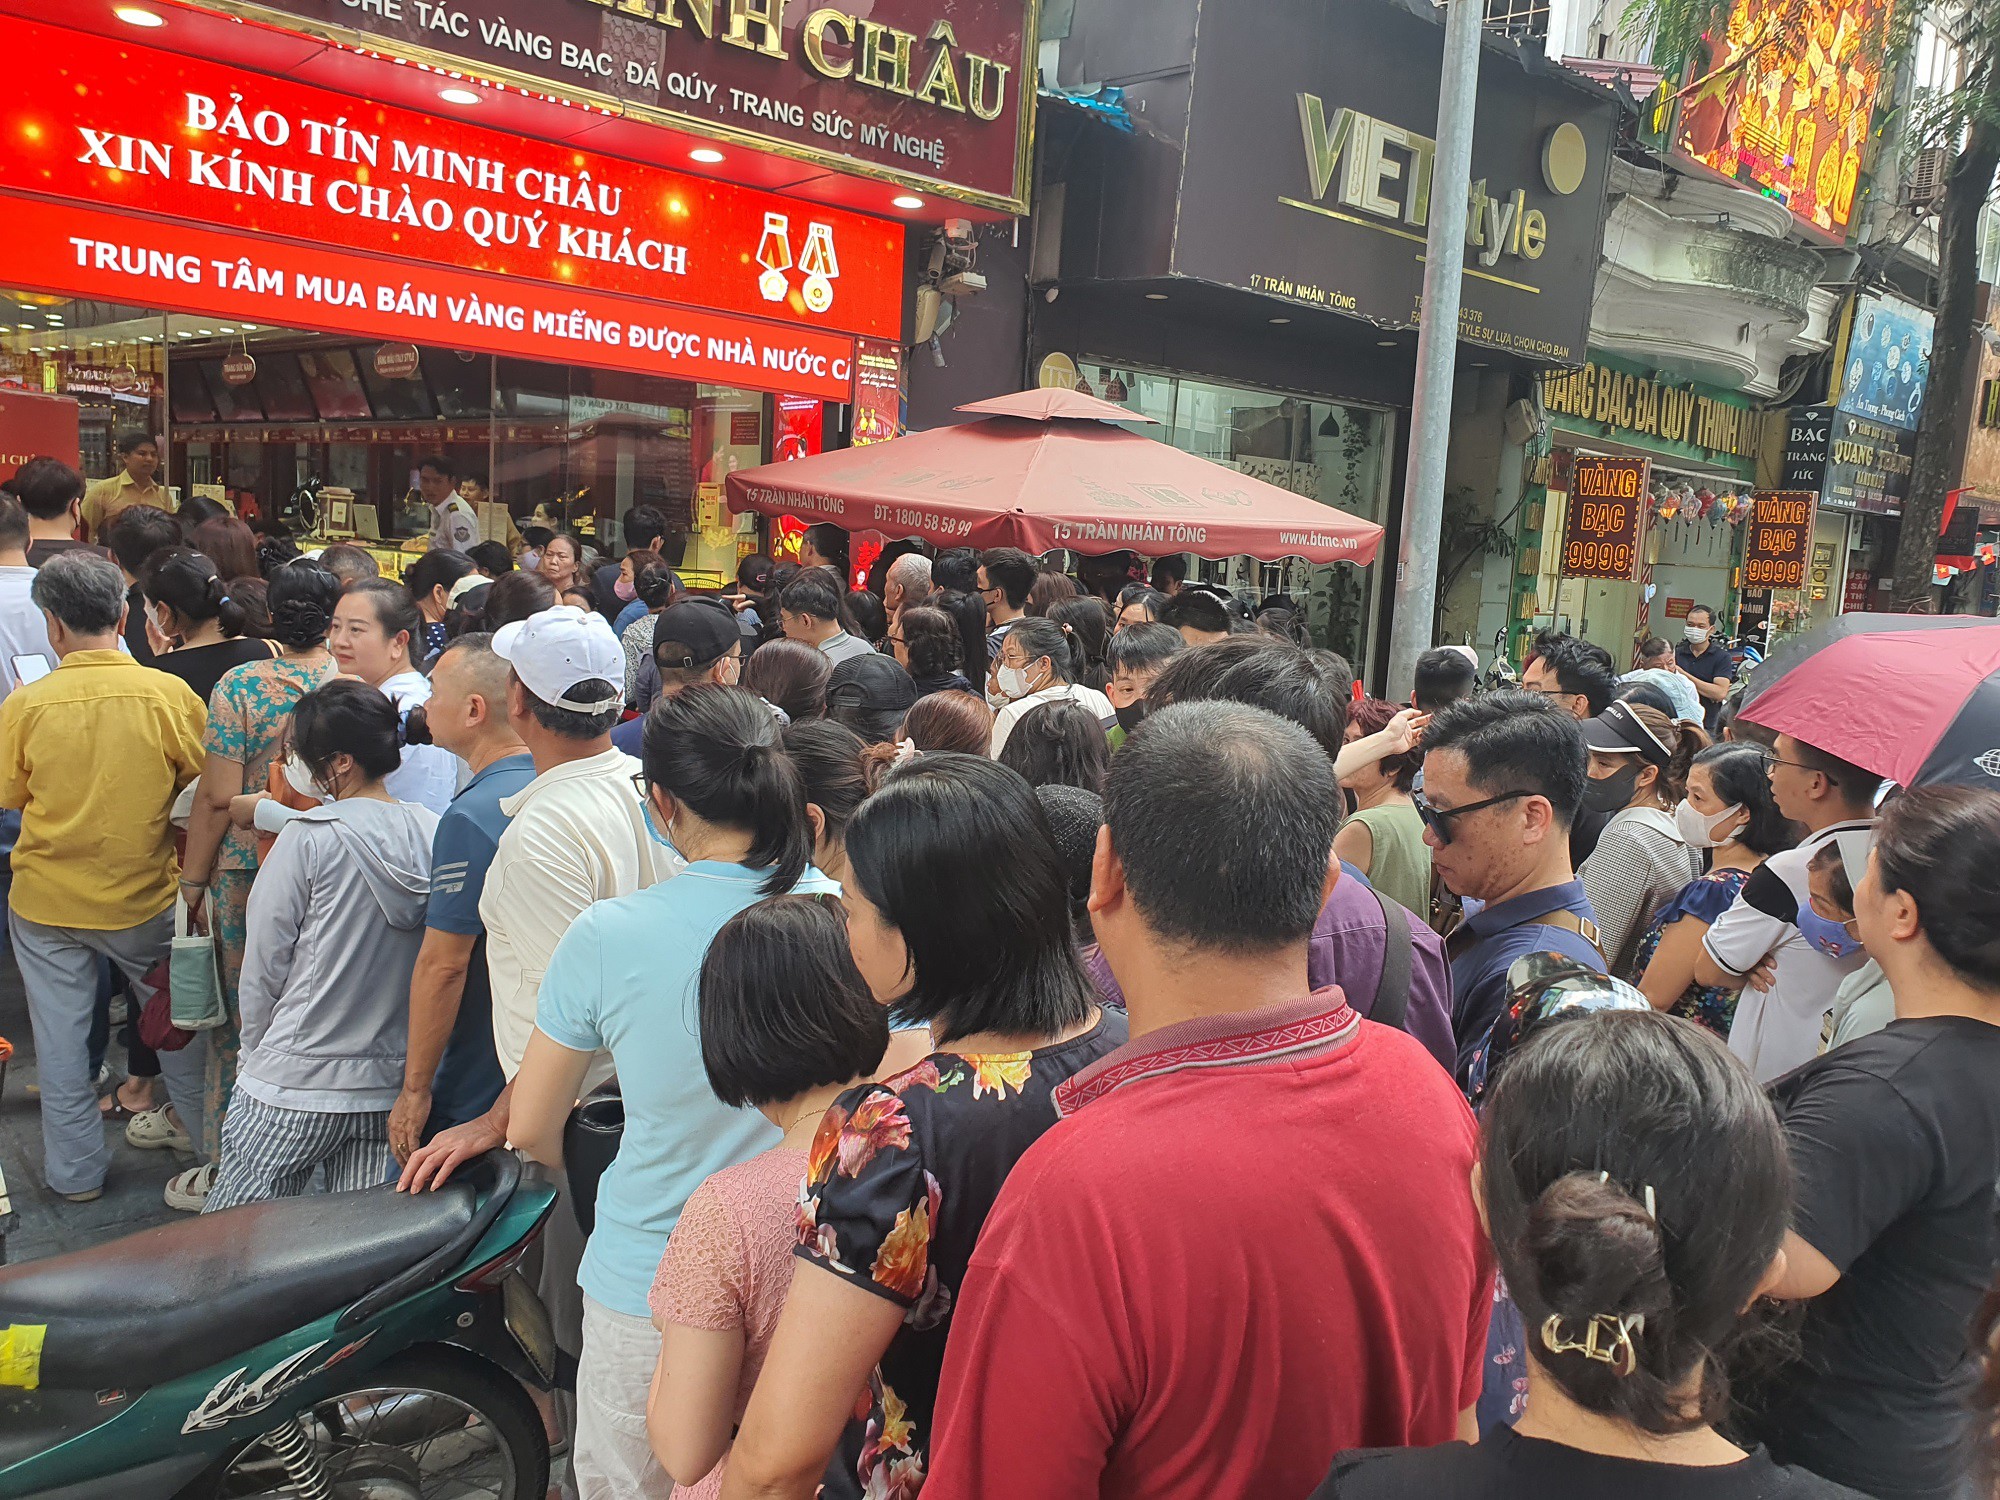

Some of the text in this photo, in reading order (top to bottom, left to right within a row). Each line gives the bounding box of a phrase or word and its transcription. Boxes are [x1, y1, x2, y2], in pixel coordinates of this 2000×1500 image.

[804, 8, 1011, 121] CHÂU
[413, 1, 470, 37] TÁC
[478, 16, 552, 60] VÀNG
[560, 42, 613, 78] BẠC
[625, 58, 660, 90] ĐÁ
[730, 88, 804, 127] TRANG
[812, 108, 853, 140] SỨC
[860, 122, 888, 149] MỸ
[893, 136, 945, 169] NGHỆ
[185, 92, 622, 217] BẢO TÍN MINH CHÂU
[77, 126, 688, 276] XIN KÍNH CHÀO QUÝ KHÁCH
[1466, 178, 1546, 266] tyle
[69, 237, 201, 284] TRUNG
[211, 257, 284, 296] TÂM
[295, 273, 367, 309] MUA
[376, 282, 437, 318] BÁN
[446, 292, 525, 331] VÀNG
[533, 308, 621, 345] MIẾNG
[628, 324, 701, 360] ĐƯỢC
[707, 336, 757, 366] NHÀ
[761, 345, 827, 376] NƯỚC
[1250, 274, 1356, 309] 17 TRẦN NHÂN TÔNG
[1469, 309, 1483, 323] 376
[1482, 327, 1494, 343] SỰ
[1496, 331, 1512, 347] LỰA
[1514, 335, 1536, 351] CHỌN
[1537, 342, 1553, 354] CHO
[1553, 345, 1569, 359] BẠN
[1596, 365, 1633, 435] BẠC
[1635, 369, 1660, 436] ĐÁ
[1661, 383, 1695, 443] QUÝ
[1791, 428, 1826, 446] BẠC
[1787, 451, 1825, 462] TRANG
[1834, 439, 1874, 467] QUANG
[1580, 463, 1637, 497] VÀNG
[1792, 468, 1814, 480] SỨC
[746, 486, 844, 514] 15 TRẦN NHÂN TÔNG
[1757, 497, 1805, 524] VÀNG
[874, 505, 972, 537] ĐT: 1800 58 58 99
[1052, 519, 1206, 543] 15 TRẦN NHÂN TÔNG
[1581, 503, 1625, 537] BẠC
[1279, 529, 1358, 550] www.btmc.vn
[1759, 528, 1797, 555] BẠC
[1568, 541, 1629, 571] 9999
[1749, 558, 1800, 583] 9999
[1742, 602, 1763, 614] HÀNH
